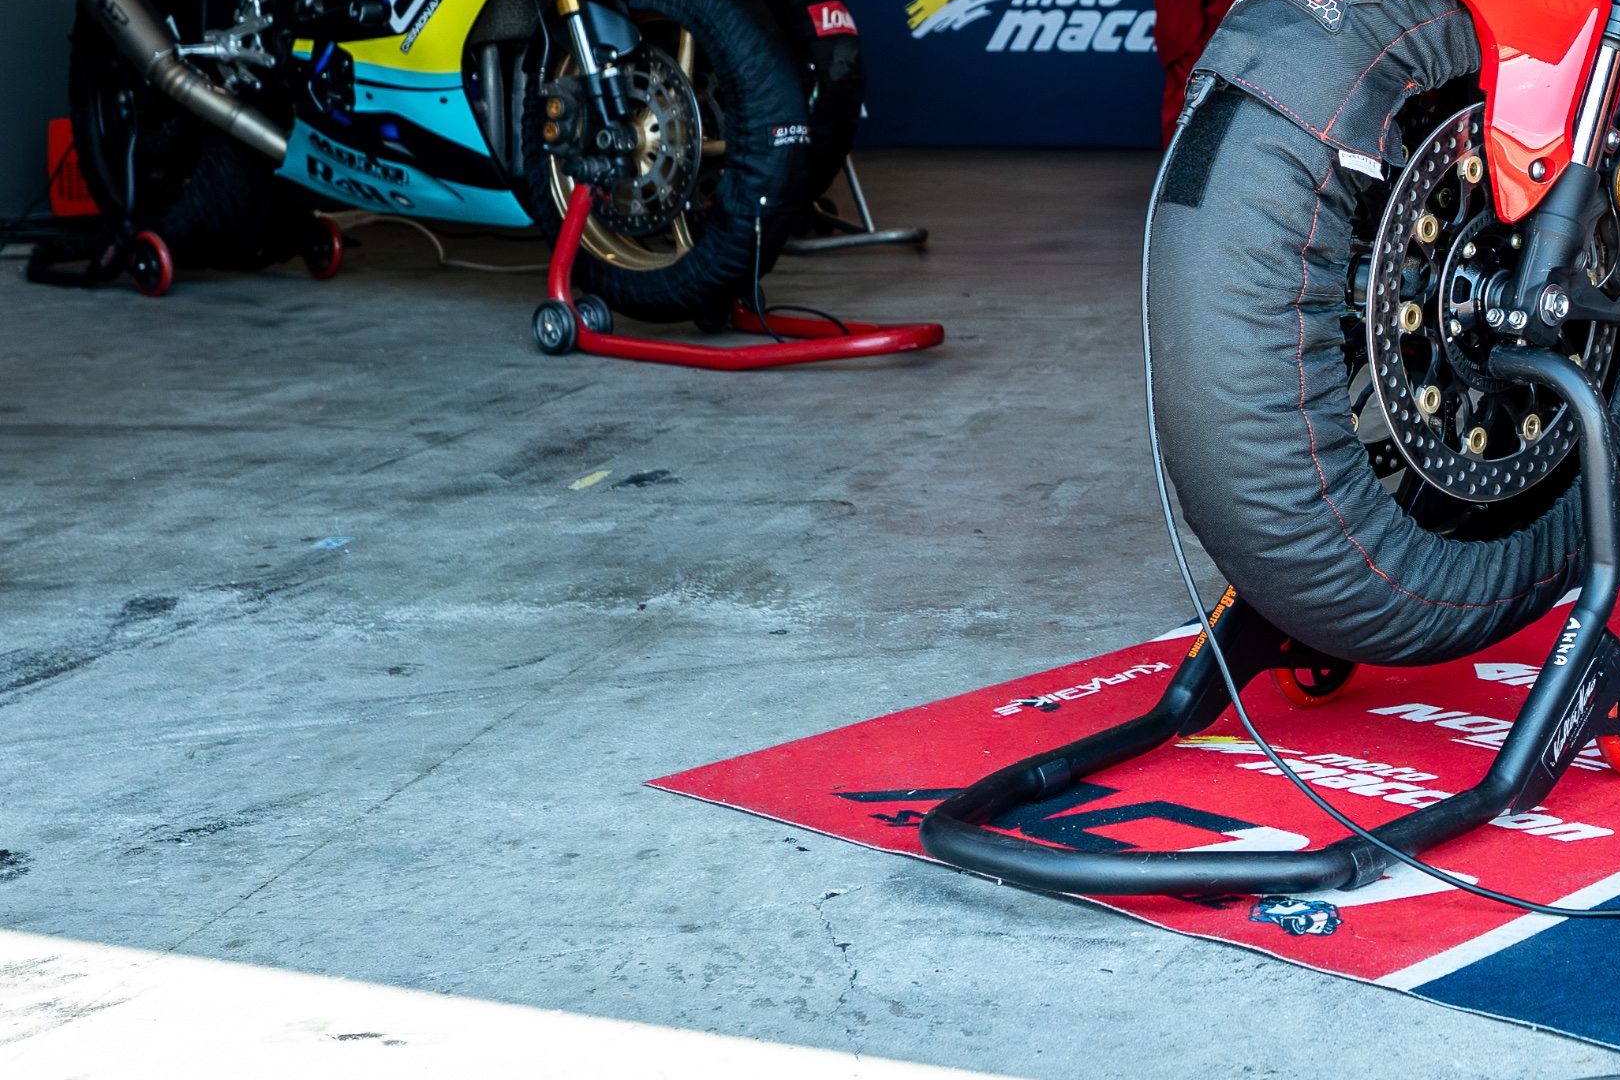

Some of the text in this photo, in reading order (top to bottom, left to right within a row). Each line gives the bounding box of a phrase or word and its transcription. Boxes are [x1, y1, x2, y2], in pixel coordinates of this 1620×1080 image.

[986, 10, 1157, 51] macc
[1188, 629, 1209, 658] ACING
[1301, 753, 1439, 782] moto
[1236, 758, 1615, 842] maccon
